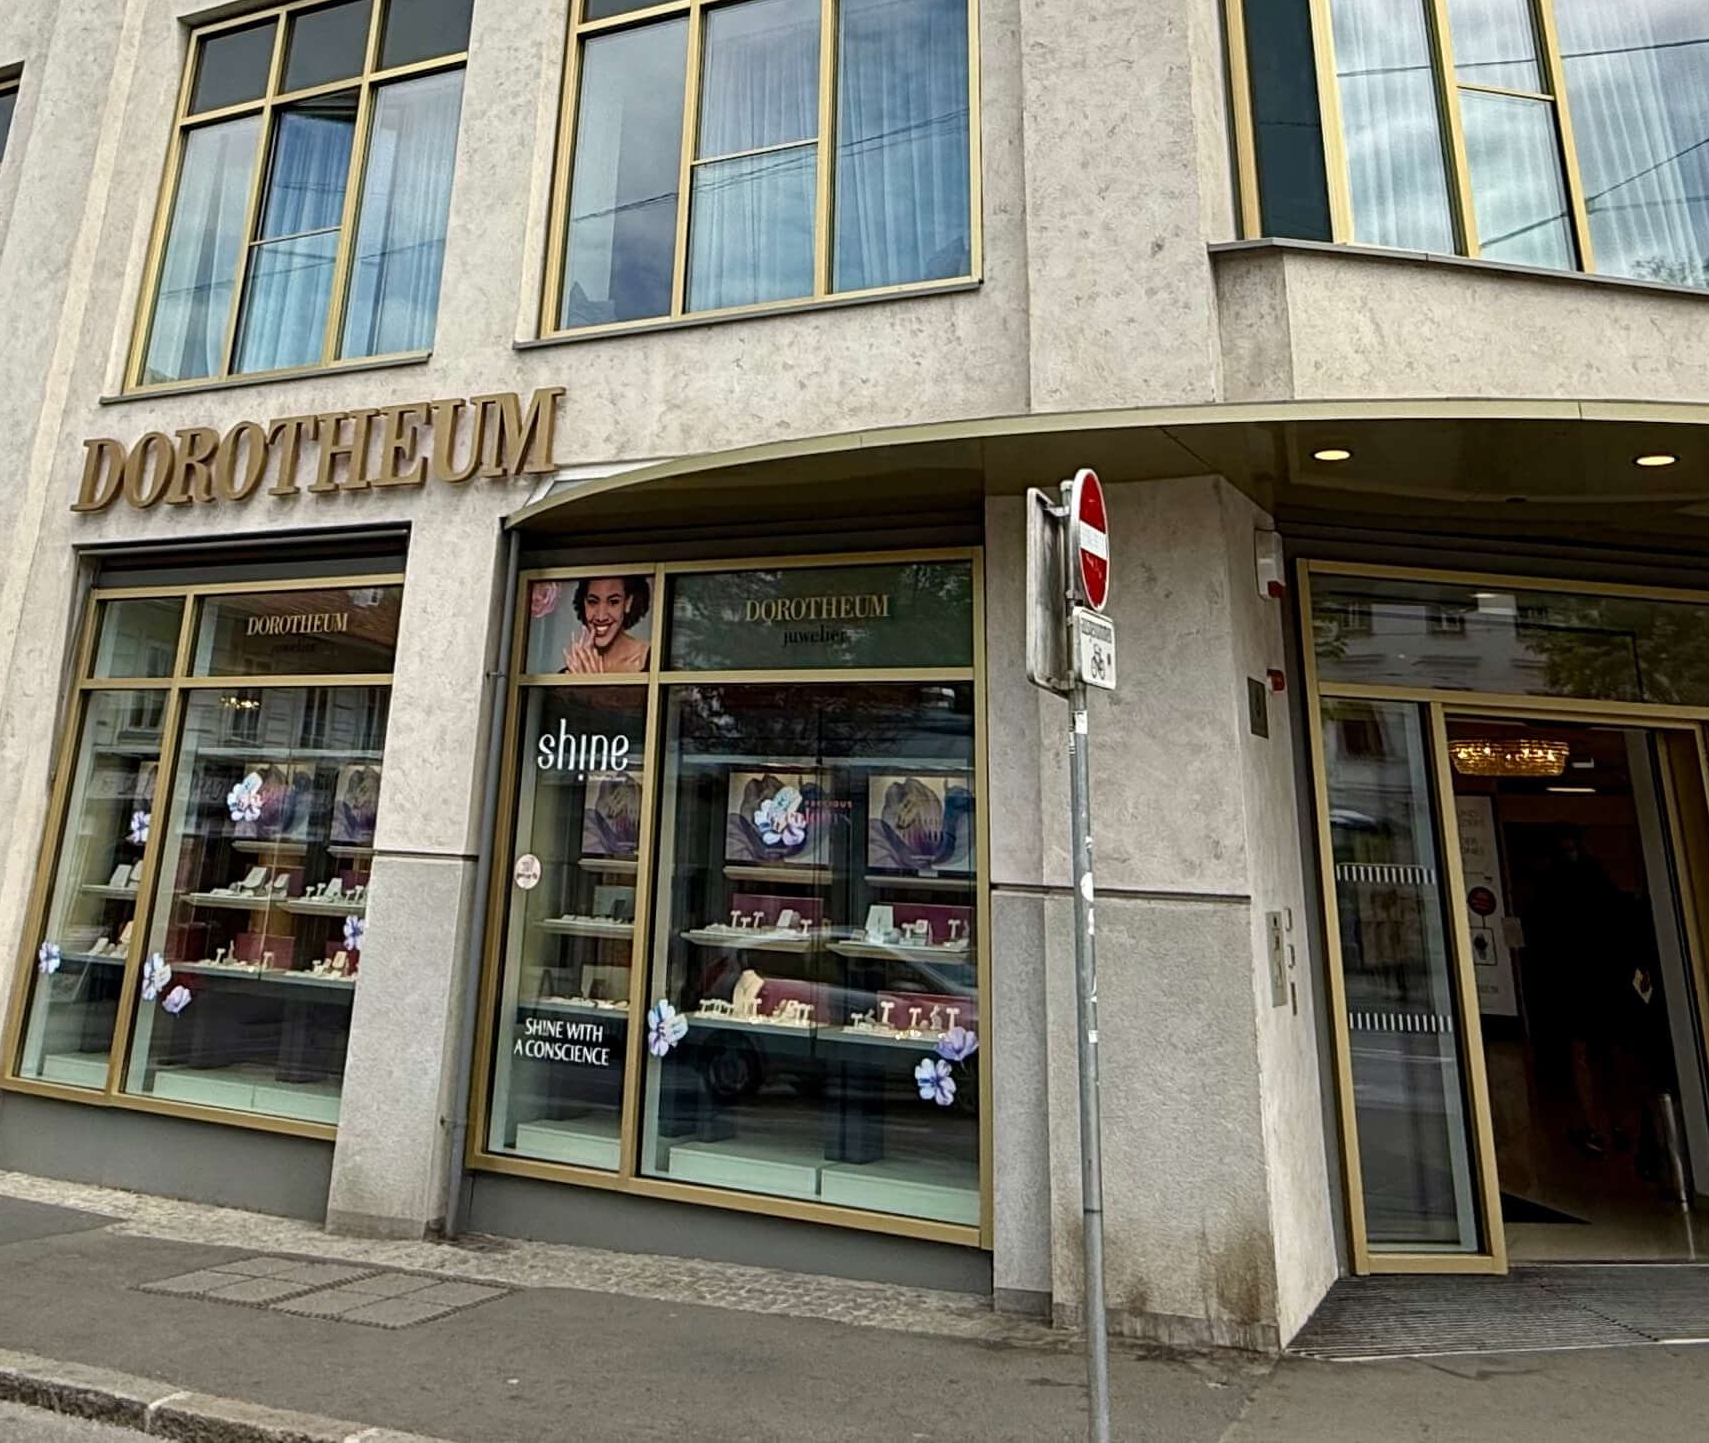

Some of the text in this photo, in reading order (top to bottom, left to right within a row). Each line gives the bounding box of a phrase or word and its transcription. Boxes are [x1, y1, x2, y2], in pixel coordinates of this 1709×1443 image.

[70, 386, 566, 511] DOROTHEUM
[745, 594, 890, 622] DOROTHEUM
[246, 613, 348, 635] DOROTHEUM
[566, 1021, 604, 1043] WITH
[513, 1038, 611, 1066] A CONSCIENCE
